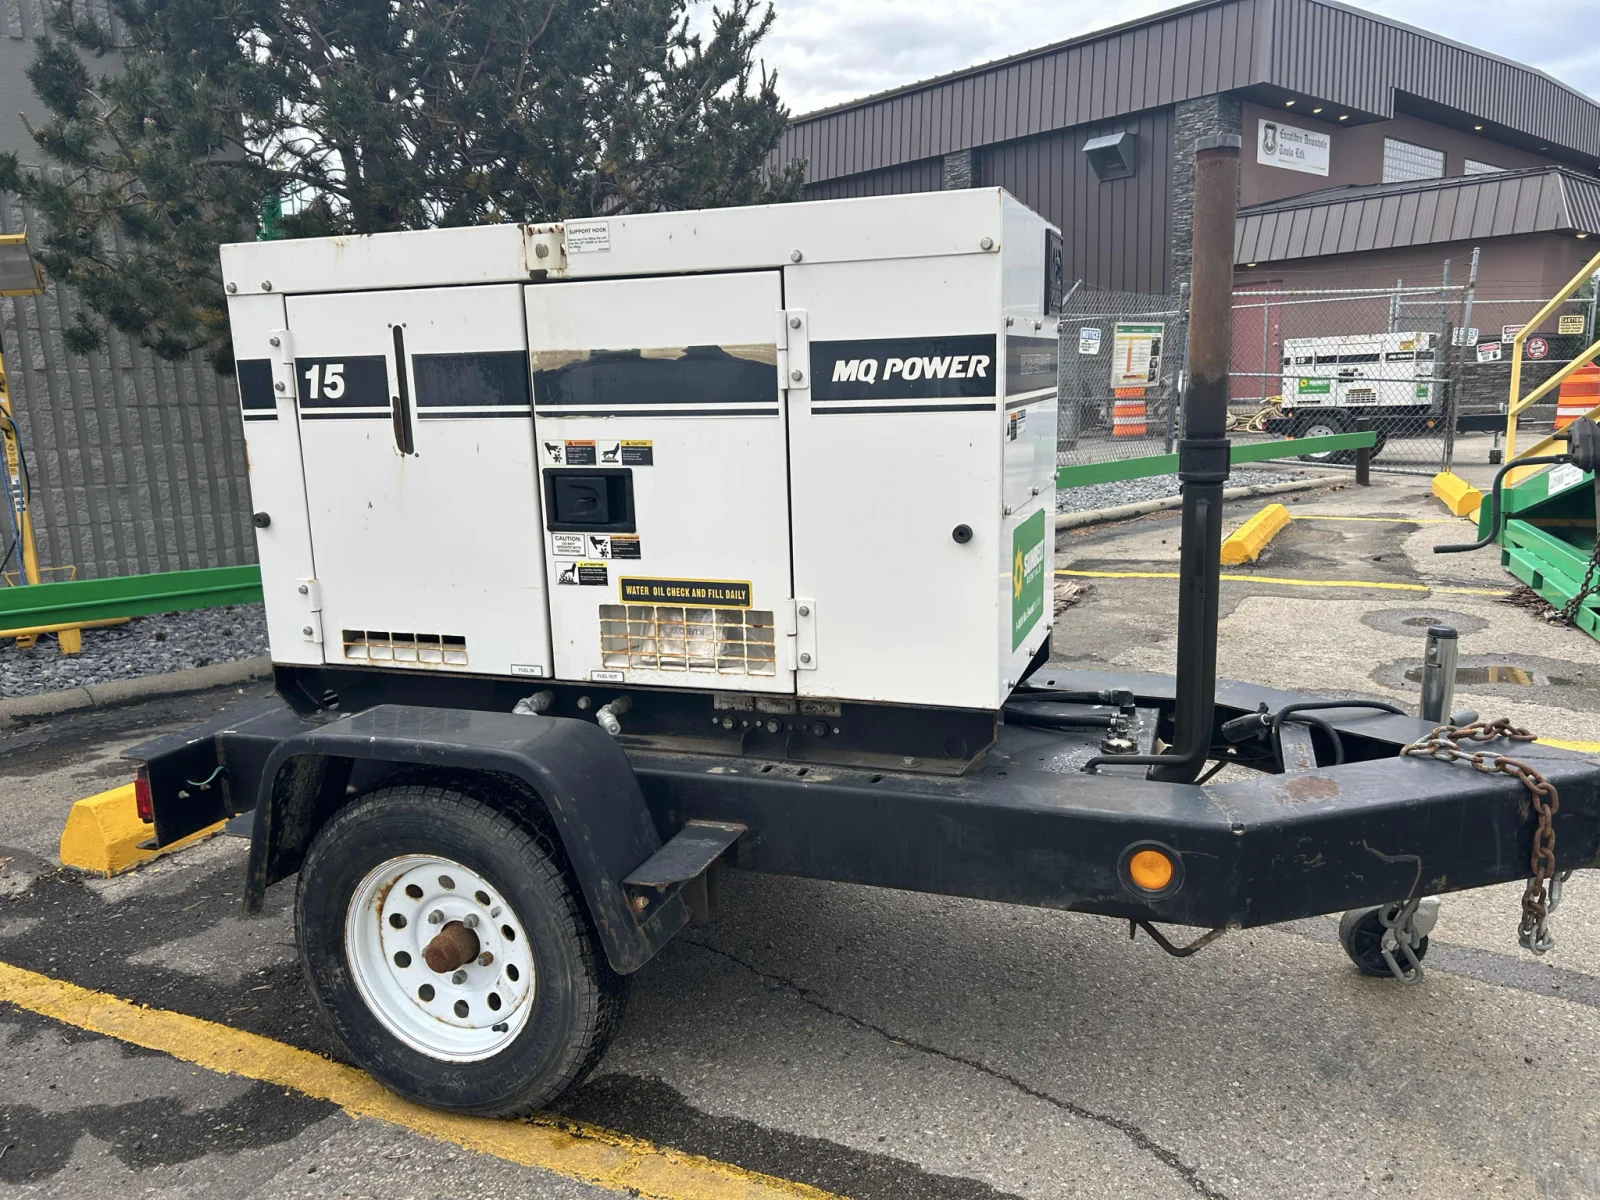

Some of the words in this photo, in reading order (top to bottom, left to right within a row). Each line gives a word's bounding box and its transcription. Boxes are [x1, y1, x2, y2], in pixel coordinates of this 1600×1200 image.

[1279, 144, 1294, 157] Tools
[1082, 330, 1099, 340] NOTICE
[831, 358, 878, 385] MQ
[882, 354, 990, 381] POWER
[305, 364, 345, 399] 15
[625, 585, 649, 596] WATER
[652, 586, 665, 597] OIL
[666, 587, 690, 598] CHECK
[691, 588, 706, 598] AND
[708, 589, 724, 599] FILL
[725, 590, 746, 600] DAILY
